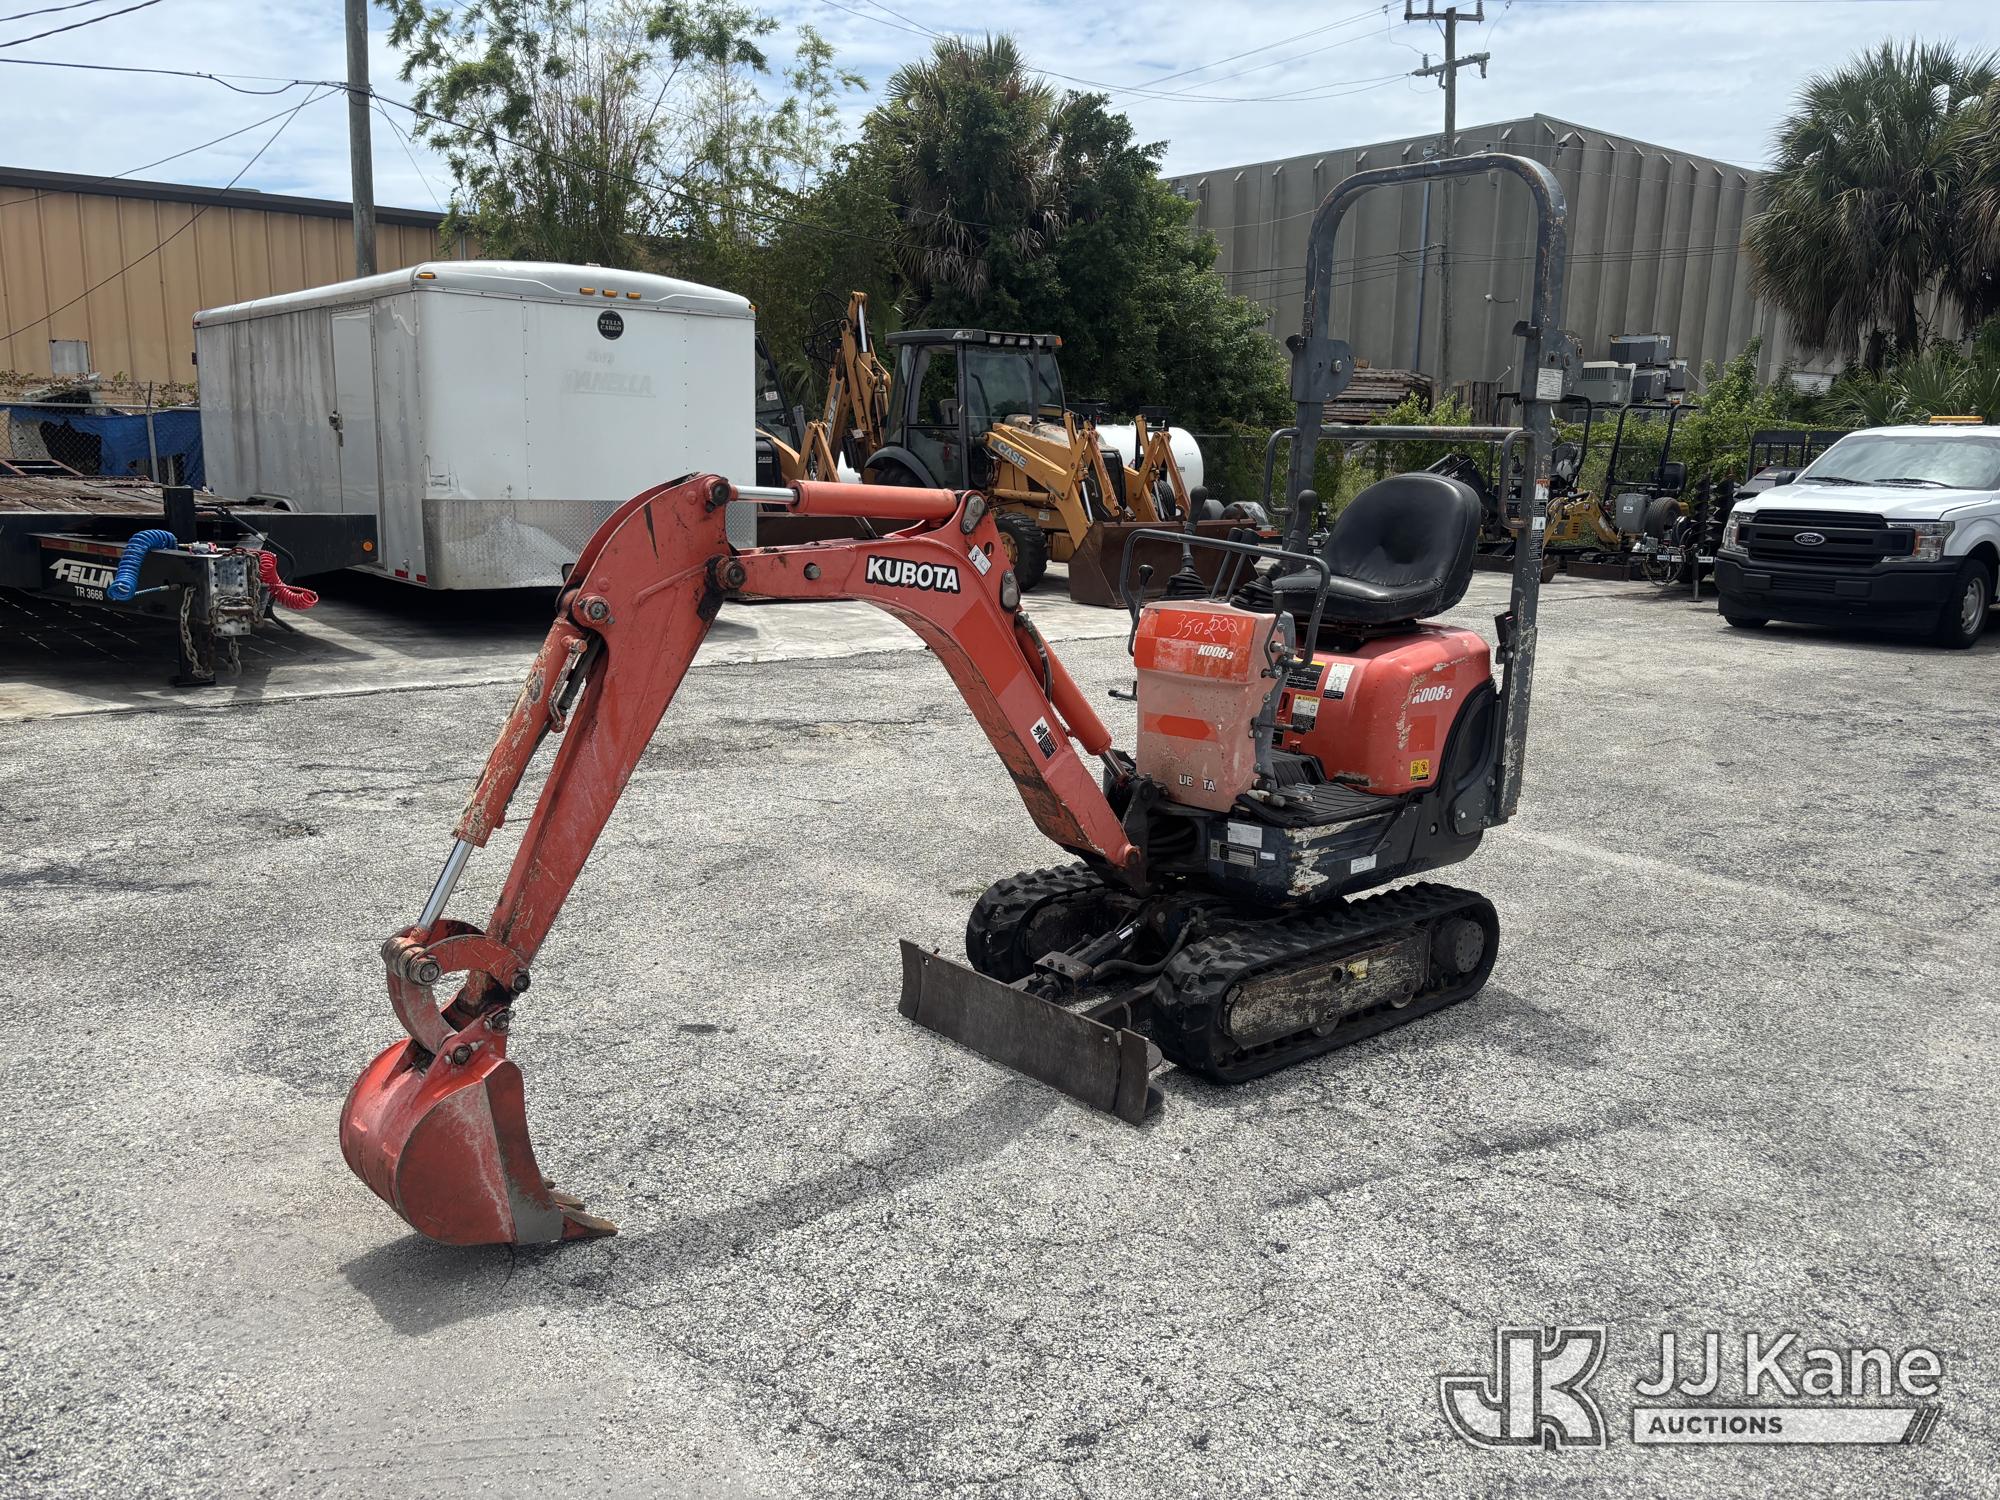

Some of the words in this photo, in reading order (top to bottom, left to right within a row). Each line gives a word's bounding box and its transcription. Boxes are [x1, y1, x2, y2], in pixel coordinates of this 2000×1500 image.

[997, 441, 1027, 469] CASE
[867, 557, 959, 591] KUBOTA
[75, 585, 86, 598] TR
[86, 587, 104, 600] 3668
[1197, 644, 1234, 660] K008-3
